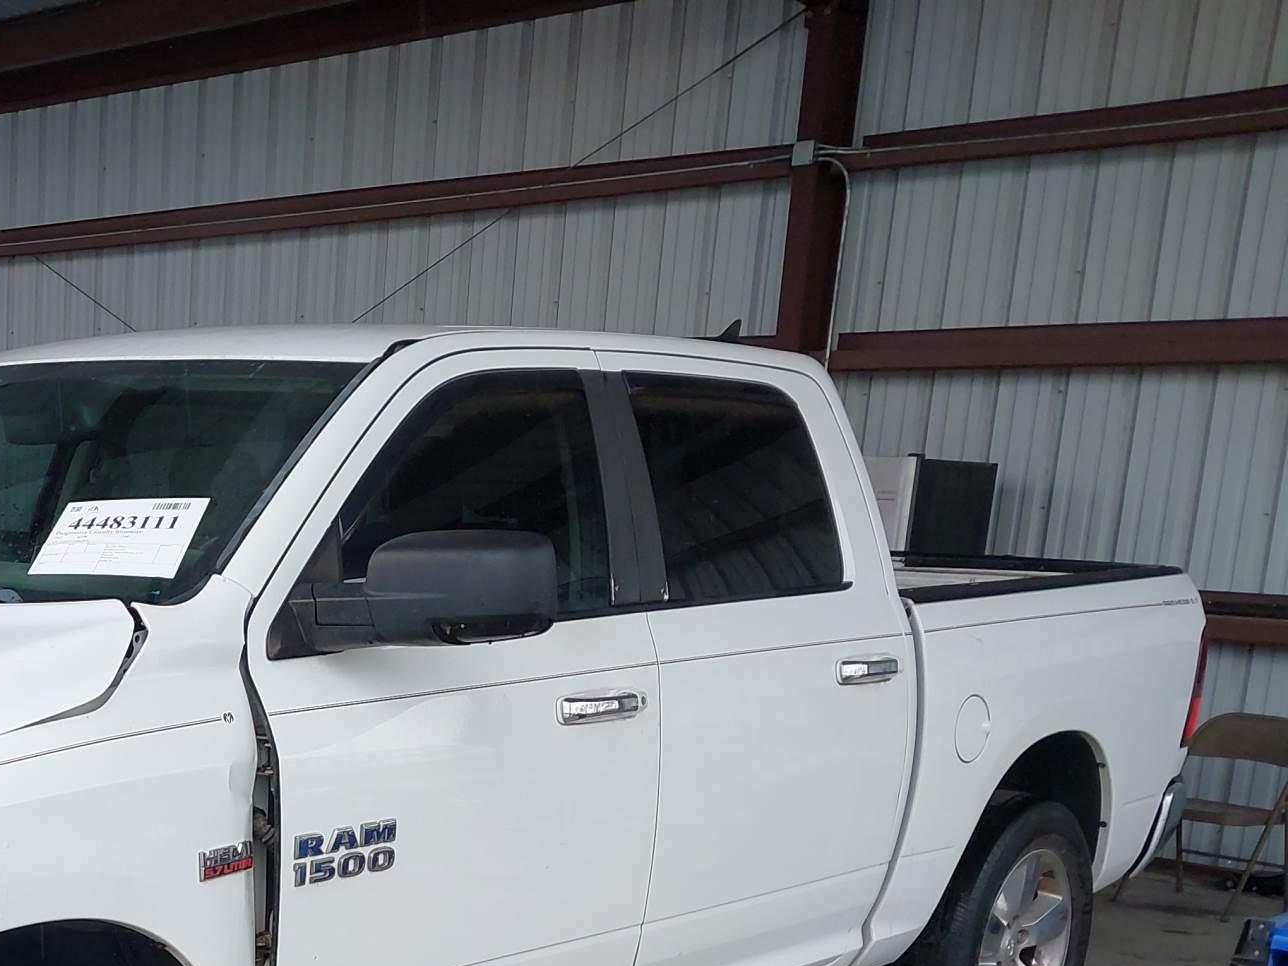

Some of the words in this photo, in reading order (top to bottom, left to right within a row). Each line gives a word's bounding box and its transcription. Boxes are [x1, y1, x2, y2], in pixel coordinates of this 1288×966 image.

[68, 515, 179, 530] 44483111
[198, 840, 253, 869] HEMI
[294, 818, 396, 860] RAM
[293, 847, 396, 887] 1500
